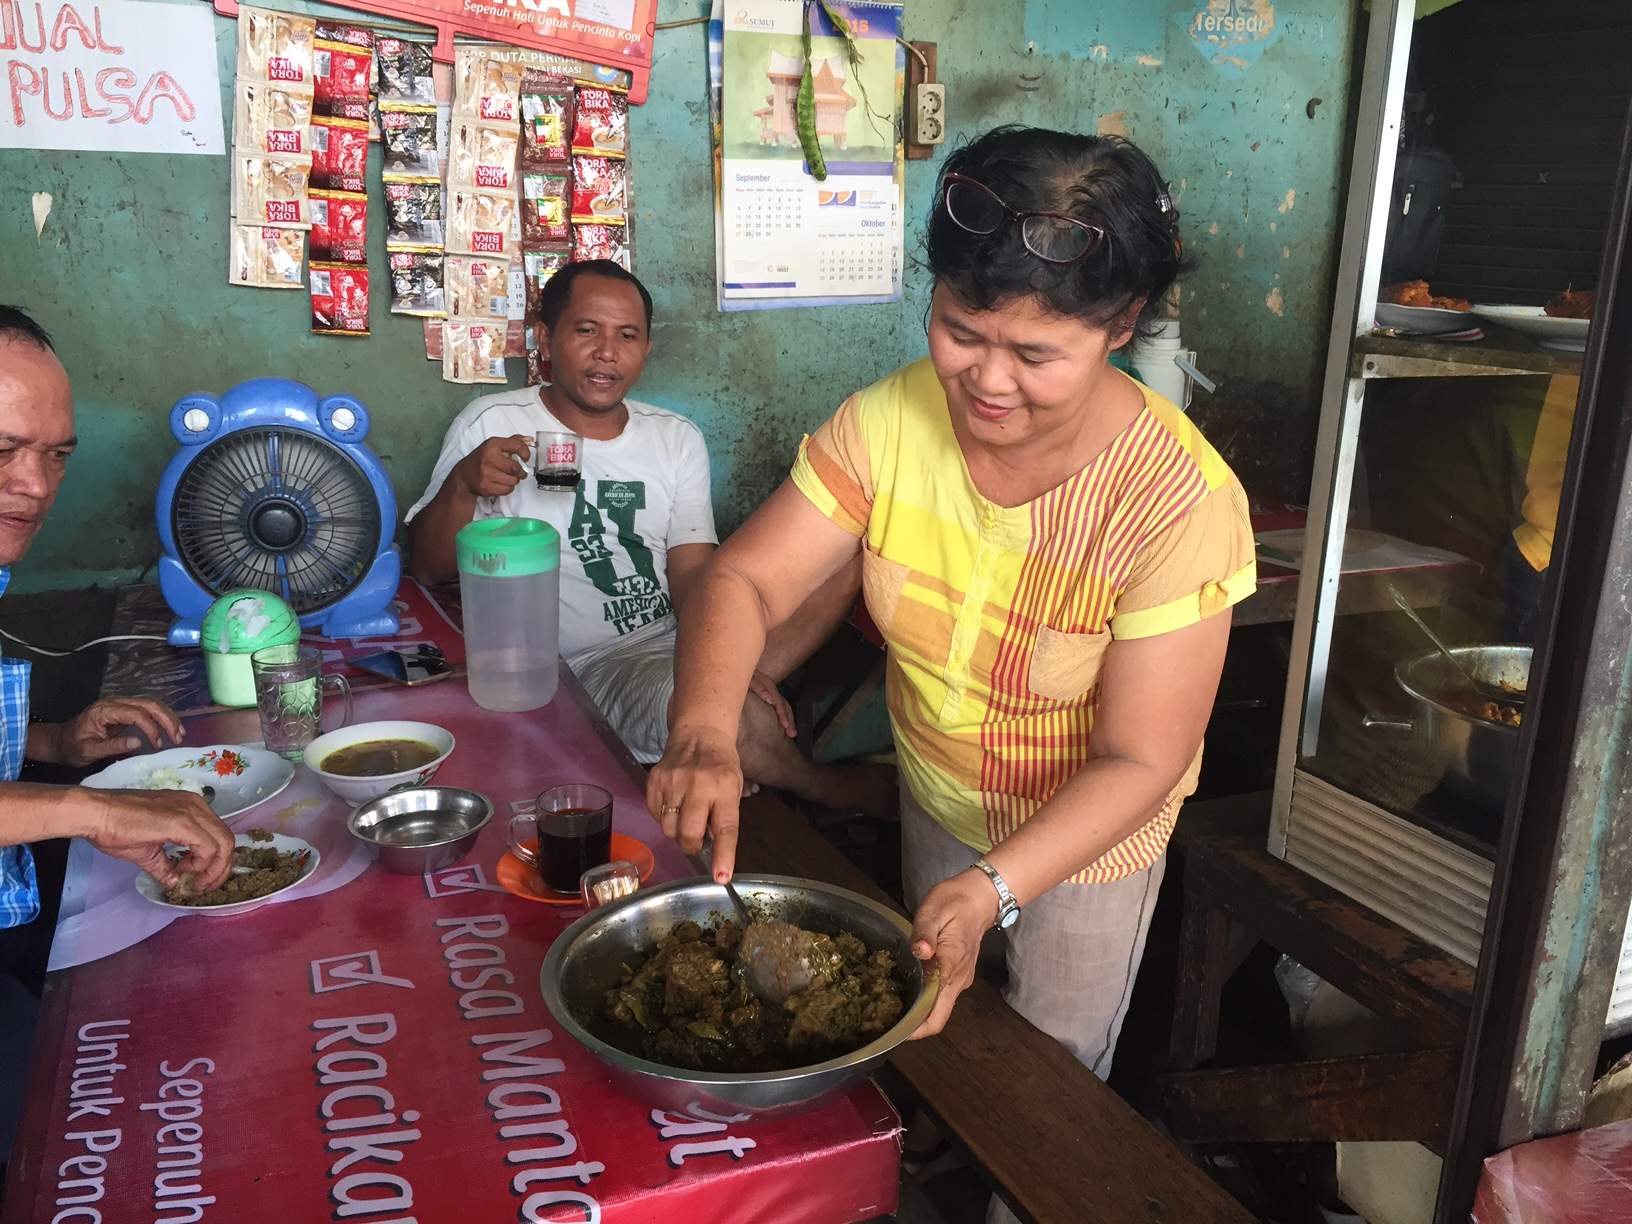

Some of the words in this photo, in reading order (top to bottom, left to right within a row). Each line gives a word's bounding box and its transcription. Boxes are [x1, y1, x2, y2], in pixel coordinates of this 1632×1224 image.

[464, 1, 510, 18] Sepenuh
[513, 9, 536, 24] Hati
[571, 20, 616, 39] Pencinta
[617, 28, 642, 44] Kopi
[491, 51, 527, 62] DUTA
[271, 69, 302, 80] TORA
[551, 66, 582, 74] BEKASI
[8, 60, 196, 127] PULSA
[581, 90, 609, 99] TORA
[585, 100, 610, 108] BIKA
[270, 141, 300, 152] TORA
[479, 176, 506, 187] TORA
[736, 173, 771, 183] September
[268, 201, 297, 213] BIKA
[269, 211, 300, 221] TORA
[861, 219, 886, 228] Oktober
[474, 233, 500, 244] BIKA
[475, 242, 502, 252] TORA
[550, 445, 574, 454] TORA
[435, 913, 525, 1020] Rasa
[64, 1018, 132, 1123] Untuk
[312, 1012, 422, 1224] Racika
[139, 1056, 217, 1224] Sepenuh
